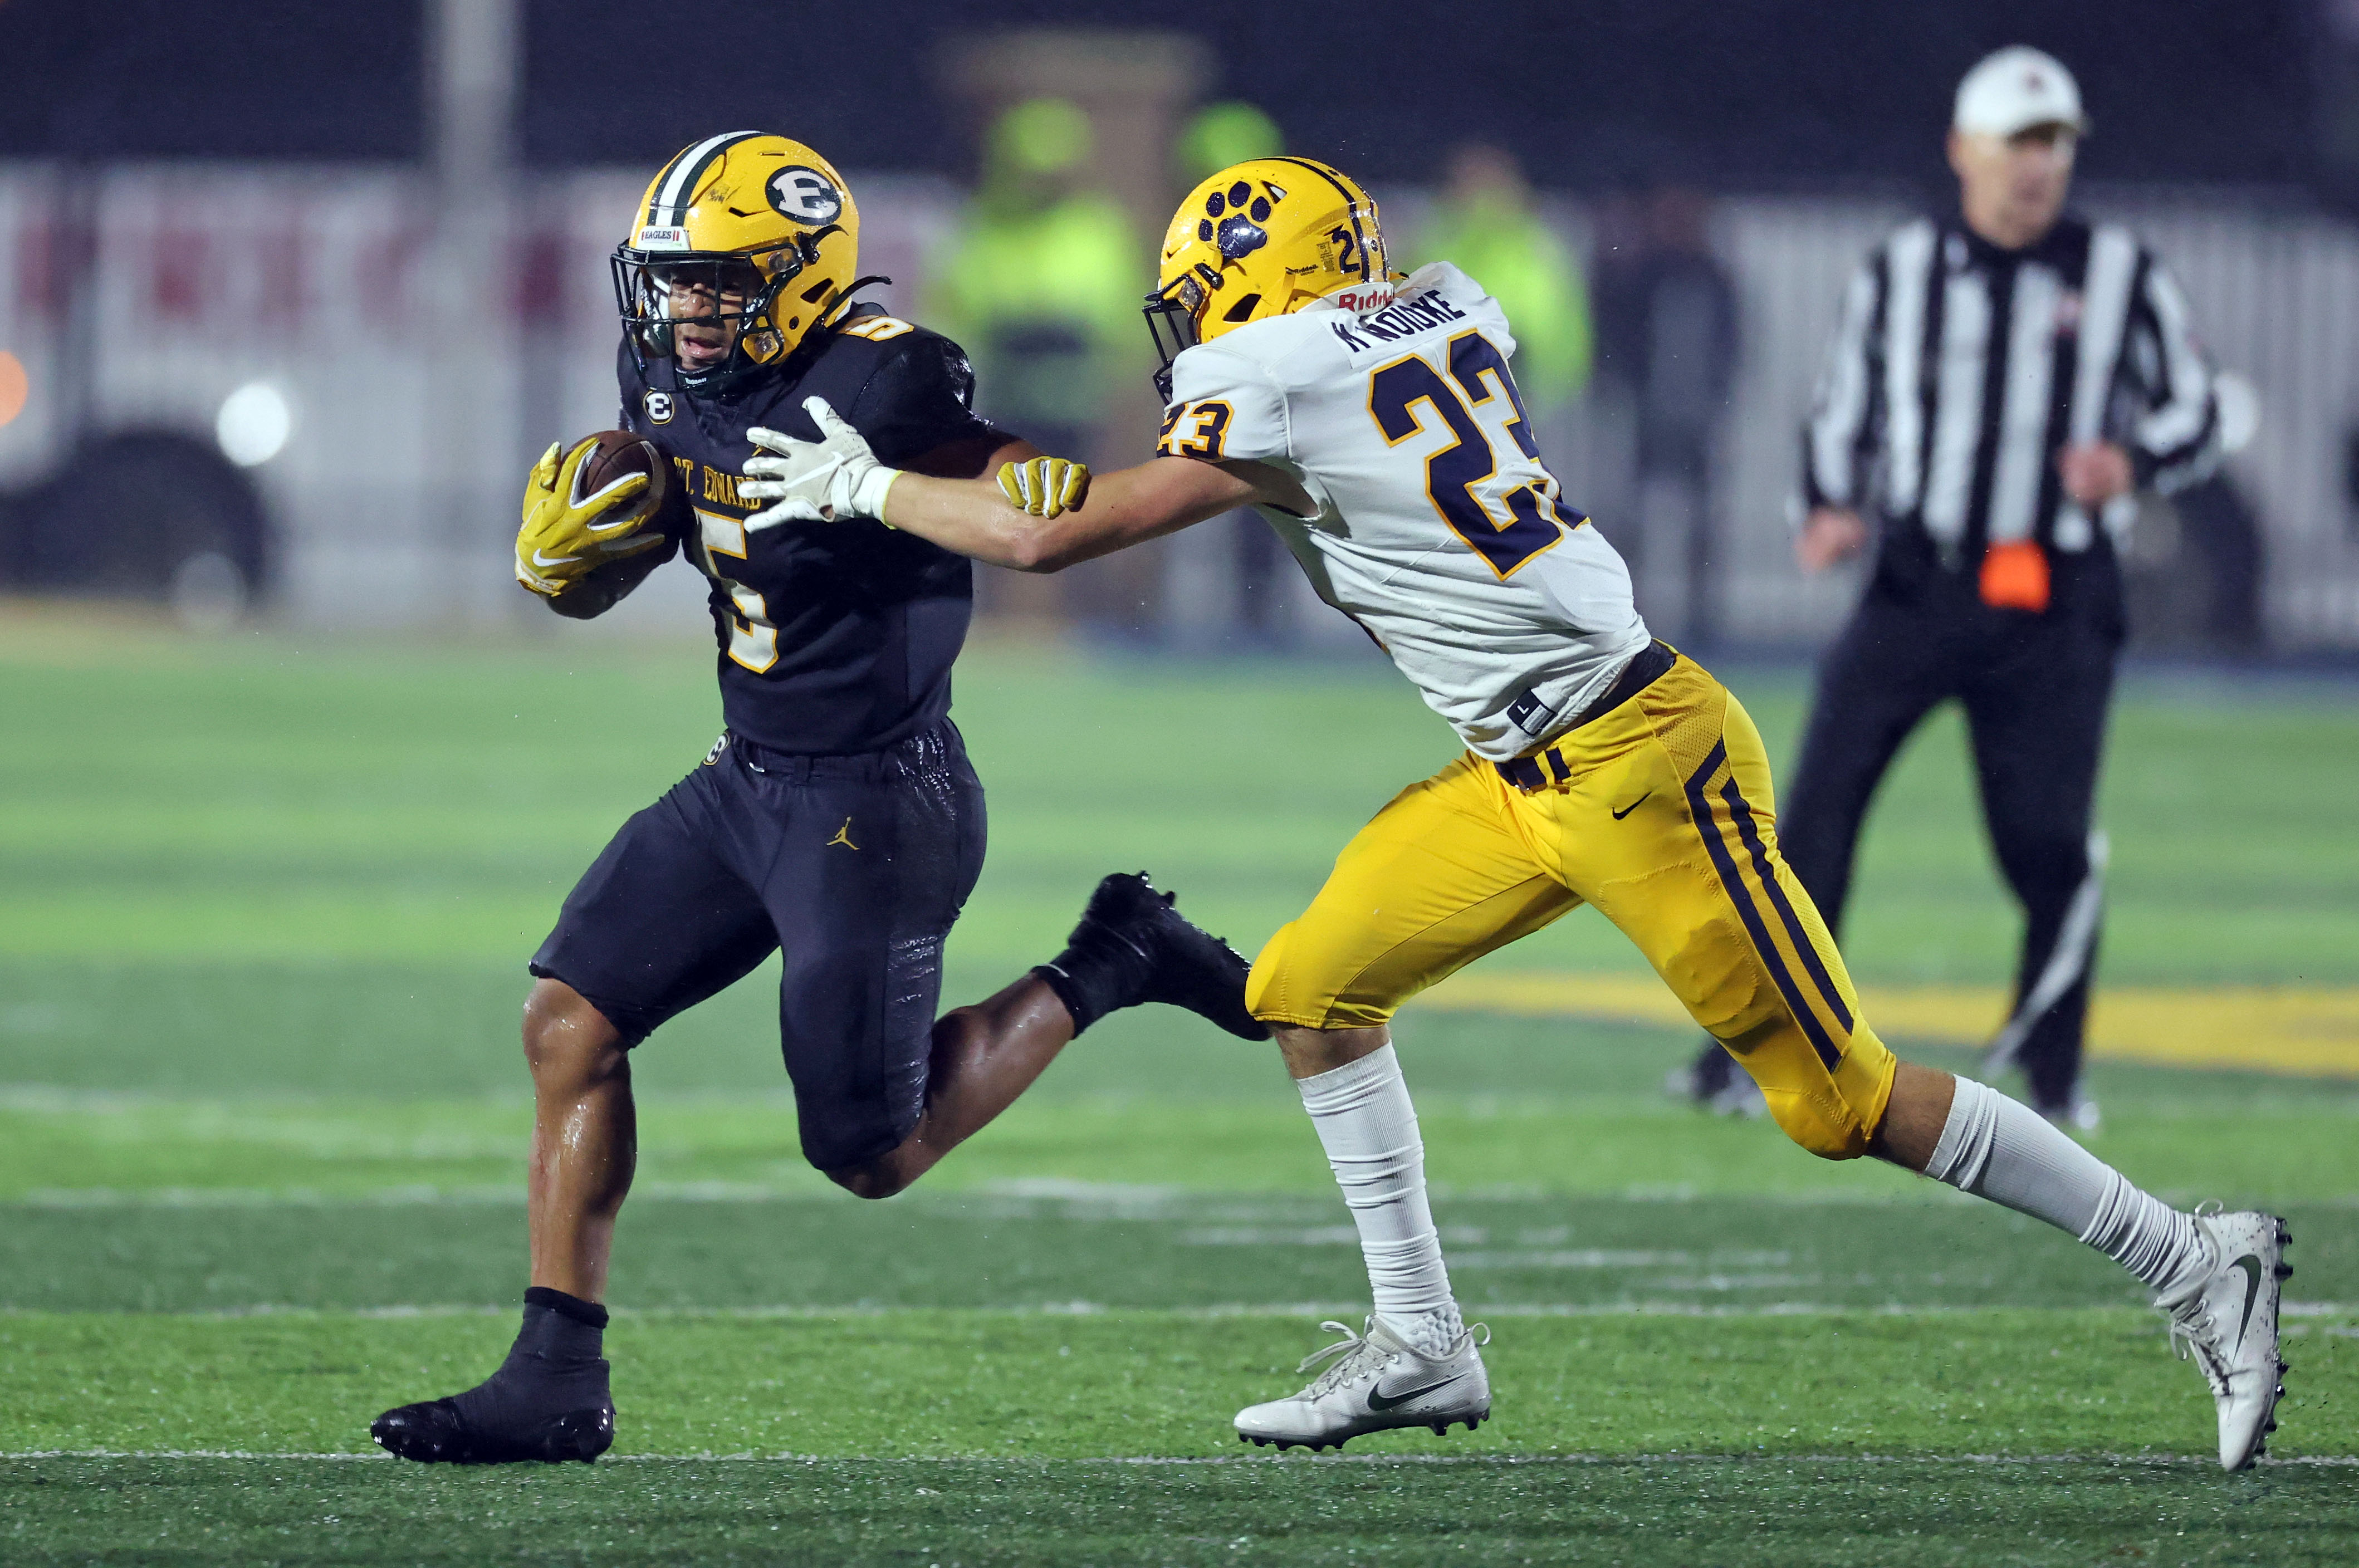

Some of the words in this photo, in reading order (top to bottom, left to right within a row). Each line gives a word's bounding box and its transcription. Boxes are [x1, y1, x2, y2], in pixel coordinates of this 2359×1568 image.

[1332, 230, 1360, 274] 2
[1157, 399, 1235, 459] 23
[1366, 327, 1591, 581] 23
[693, 505, 779, 674] 5
[1517, 705, 1529, 714] L
